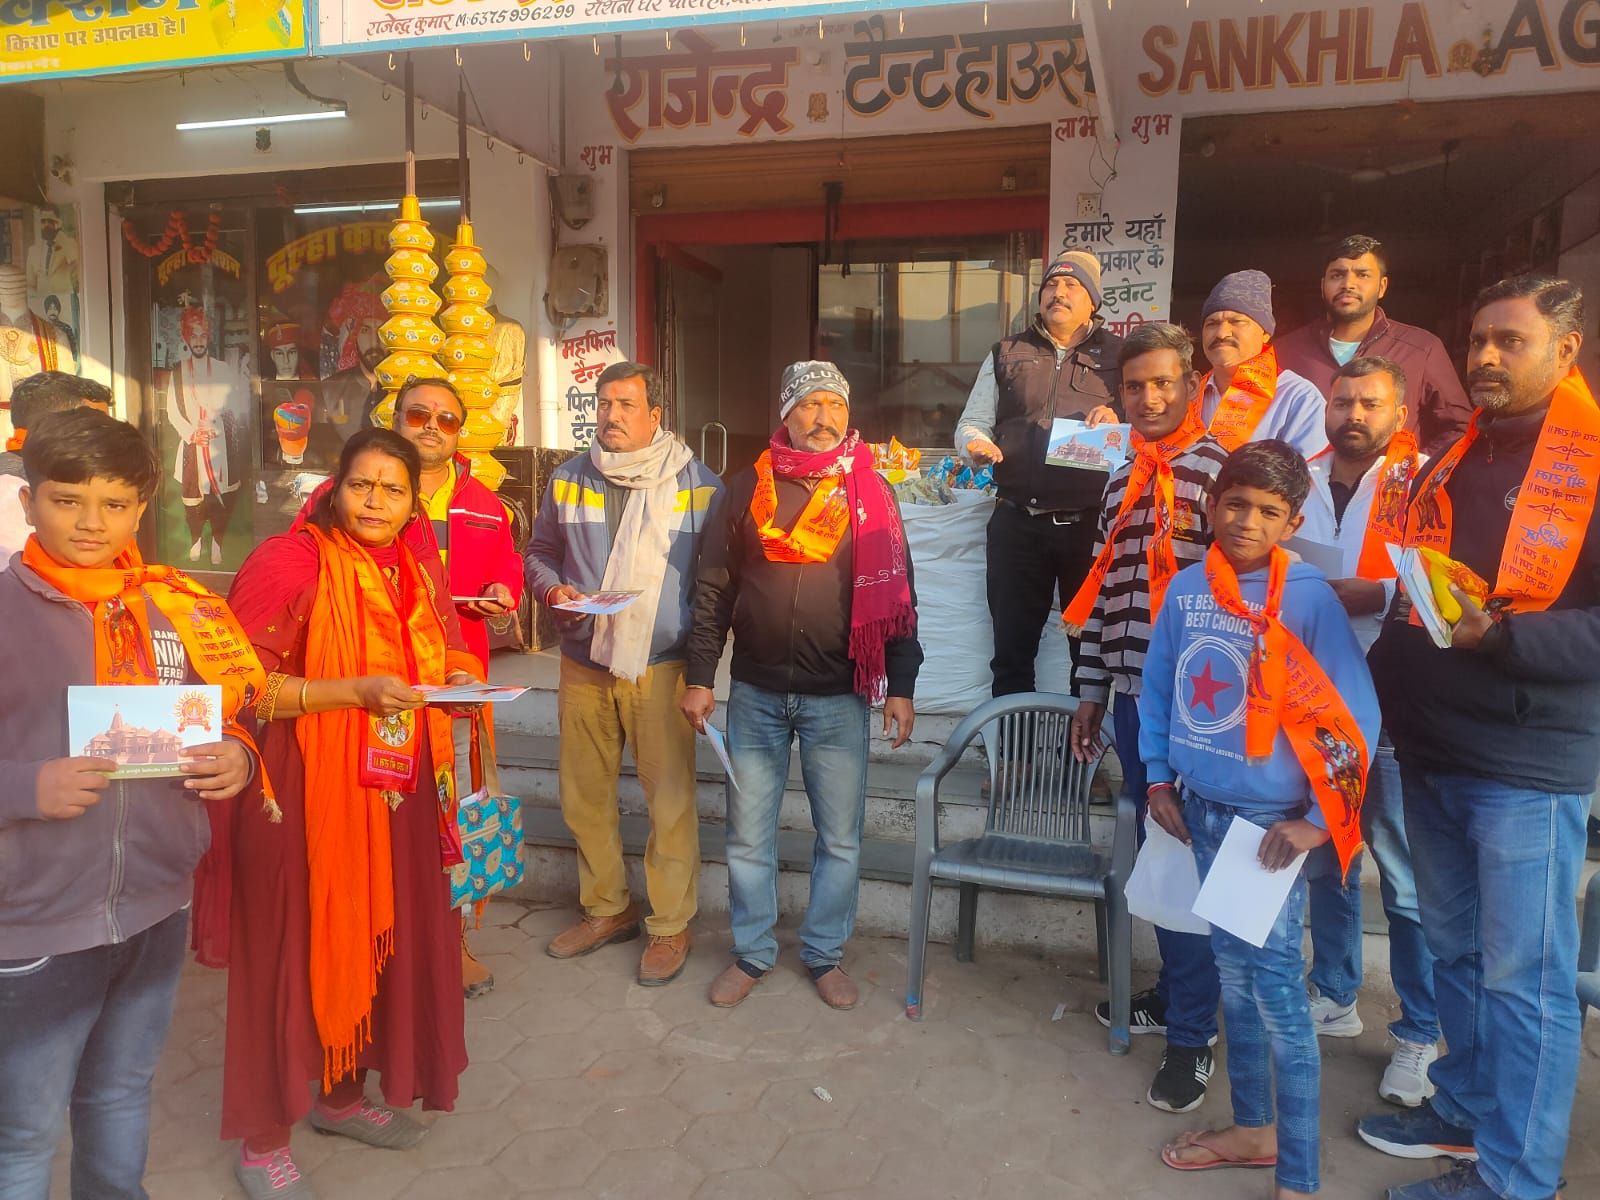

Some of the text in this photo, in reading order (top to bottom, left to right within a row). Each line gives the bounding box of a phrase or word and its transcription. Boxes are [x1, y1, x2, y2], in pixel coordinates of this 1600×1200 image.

[6, 34, 59, 52] किराए
[64, 30, 87, 46] पर
[92, 22, 159, 44] उपलब्ध
[414, 14, 454, 36] कुमार
[1138, 1, 1441, 96] SANKHLA
[605, 29, 801, 144] राजेन्द्र
[1055, 115, 1099, 142] लाभ
[1131, 114, 1173, 144] शुभ
[580, 144, 613, 171] शुभ
[1063, 212, 1115, 248] हमारे
[1147, 244, 1165, 268] के
[1185, 612, 1254, 637] BEST CHOICE
[152, 639, 185, 669] NIM
[156, 667, 183, 679] TERE
